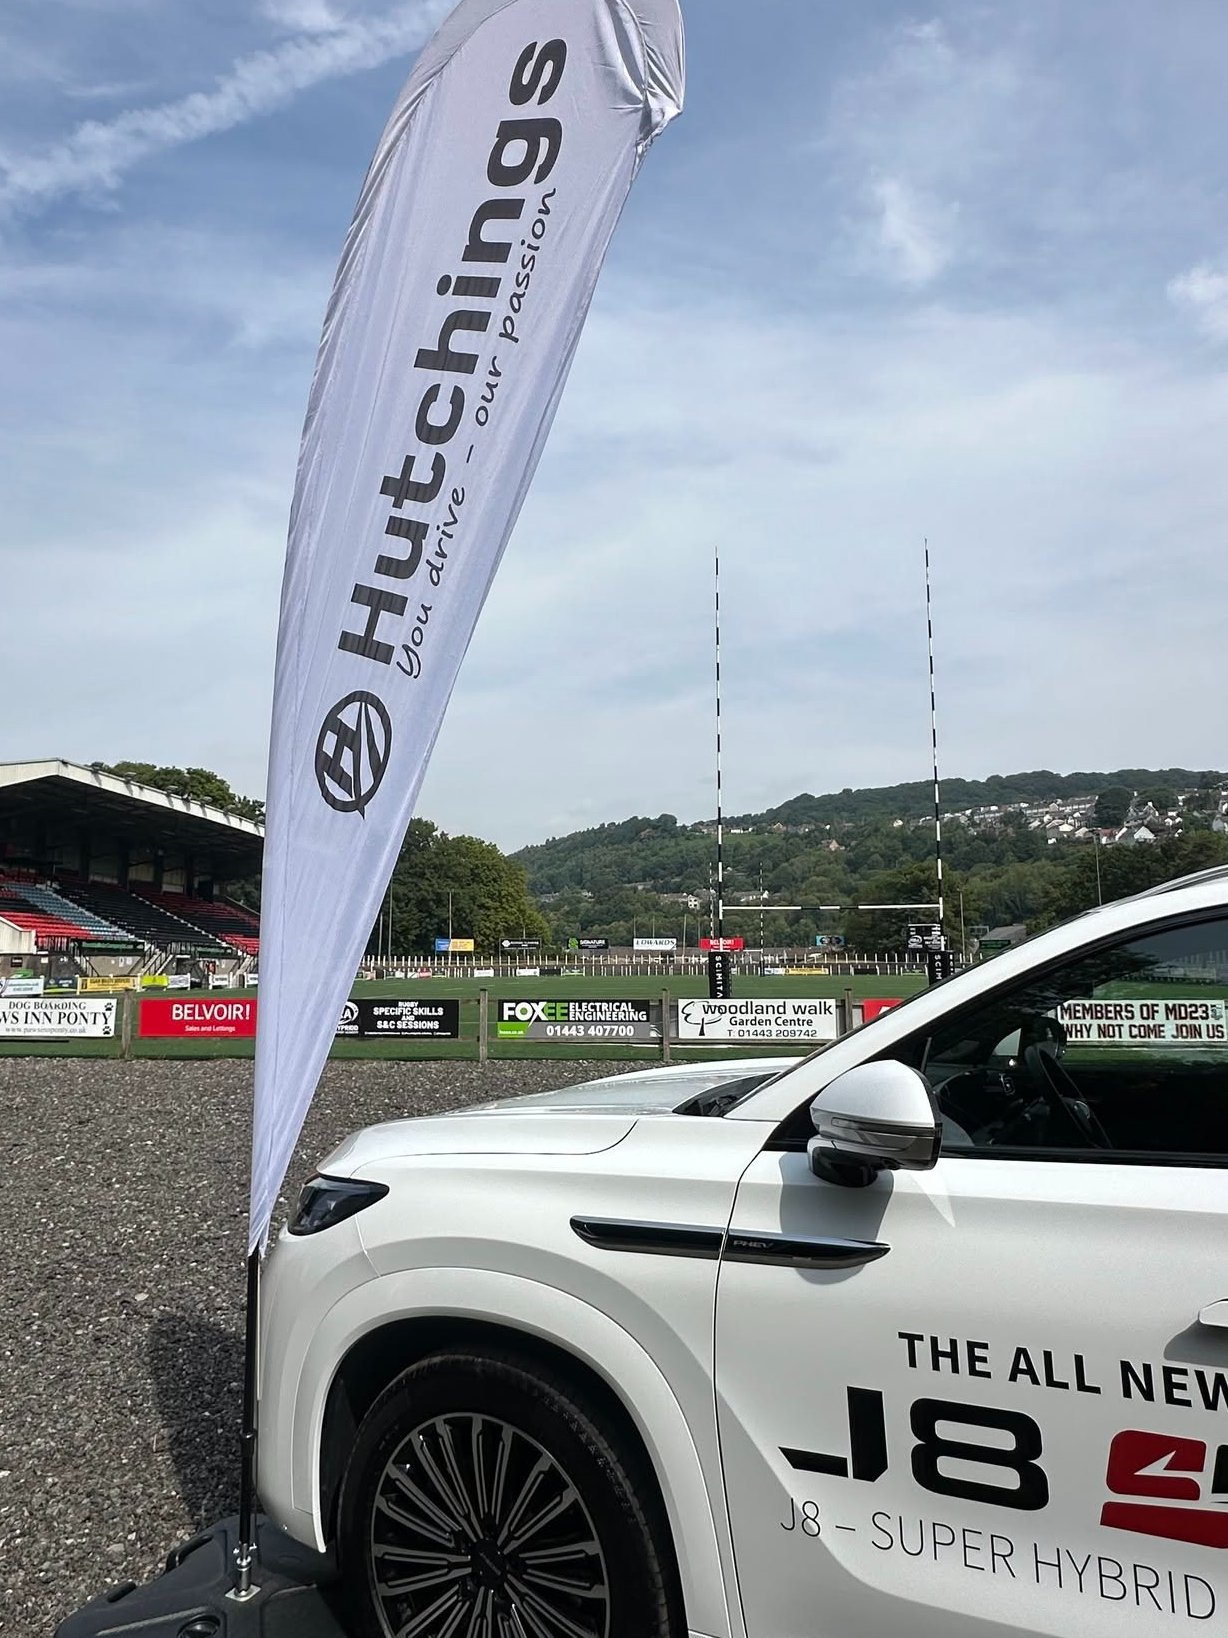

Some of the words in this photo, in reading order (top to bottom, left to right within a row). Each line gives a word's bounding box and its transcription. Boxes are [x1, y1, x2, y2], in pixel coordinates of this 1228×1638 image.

[337, 38, 568, 666] Hutchings
[396, 603, 433, 679] You
[426, 486, 466, 587] drive
[475, 355, 502, 427] our
[498, 187, 557, 344] passion
[9, 1001, 31, 1010] DOG
[33, 1001, 87, 1010] BOARDING
[172, 1003, 251, 1020] BELVOIR!
[373, 1007, 411, 1016] SPECIFIC
[412, 1007, 444, 1016] SKILLS
[569, 1002, 635, 1012] ELECTRICAL
[702, 1001, 787, 1015] woodland
[792, 1001, 833, 1015] walk
[1060, 1003, 1135, 1020] MEMBERS
[1139, 1003, 1159, 1020] OF
[1165, 1003, 1209, 1020] MD23
[24, 1011, 53, 1025] INN
[57, 1011, 112, 1025] PONTY
[569, 1011, 647, 1021] ENGINEERING
[729, 1016, 772, 1026] Garden
[775, 1016, 814, 1026] Centre
[184, 1024, 200, 1032] Sales
[200, 1024, 212, 1032] and
[212, 1024, 236, 1033] Lettings
[376, 1021, 396, 1029] S&C
[396, 1021, 440, 1029] SESSIONS
[546, 1025, 585, 1037] 01443
[587, 1025, 635, 1037] 407700
[1064, 1023, 1093, 1039] WHY
[1097, 1023, 1124, 1039] NOT
[1128, 1023, 1166, 1039] COME
[1171, 1023, 1203, 1039] JOIN
[1206, 1023, 1225, 1039] US
[738, 1029, 773, 1037] 01443
[775, 1029, 818, 1037] 209742
[732, 1239, 774, 1249] PHEV
[898, 1331, 993, 1380] THE
[1008, 1347, 1102, 1395] ALL
[1119, 1360, 1228, 1412] NEW
[778, 1385, 1050, 1511] J8
[780, 1497, 822, 1538] J8
[871, 1511, 1016, 1578] SUPER
[1033, 1542, 1217, 1620] HYBRID
